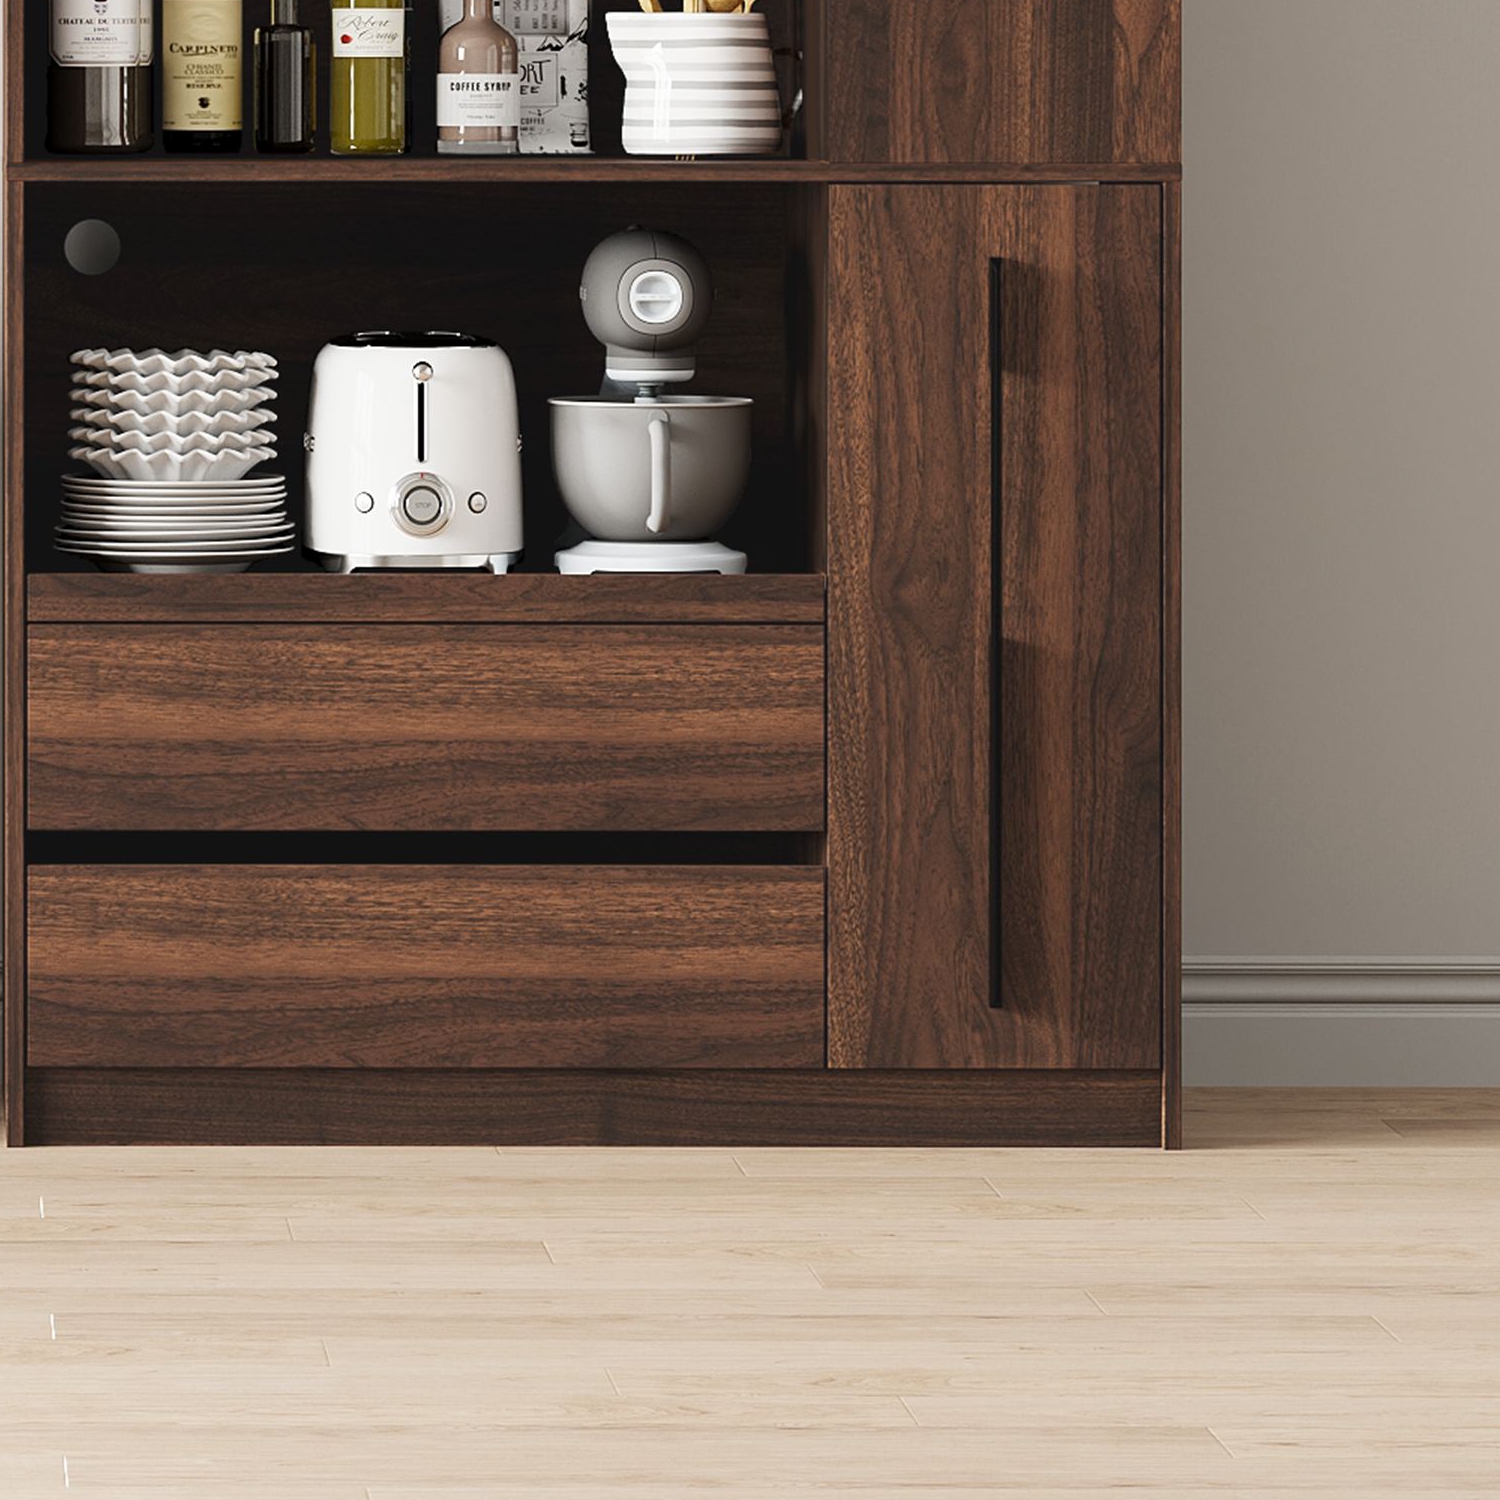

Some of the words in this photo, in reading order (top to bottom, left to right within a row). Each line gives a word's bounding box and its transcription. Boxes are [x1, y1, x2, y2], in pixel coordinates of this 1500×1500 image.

[337, 15, 390, 31] Robert
[169, 42, 238, 54] CARPINETO
[450, 82, 481, 92] COFFEE
[484, 82, 511, 92] SYRUP
